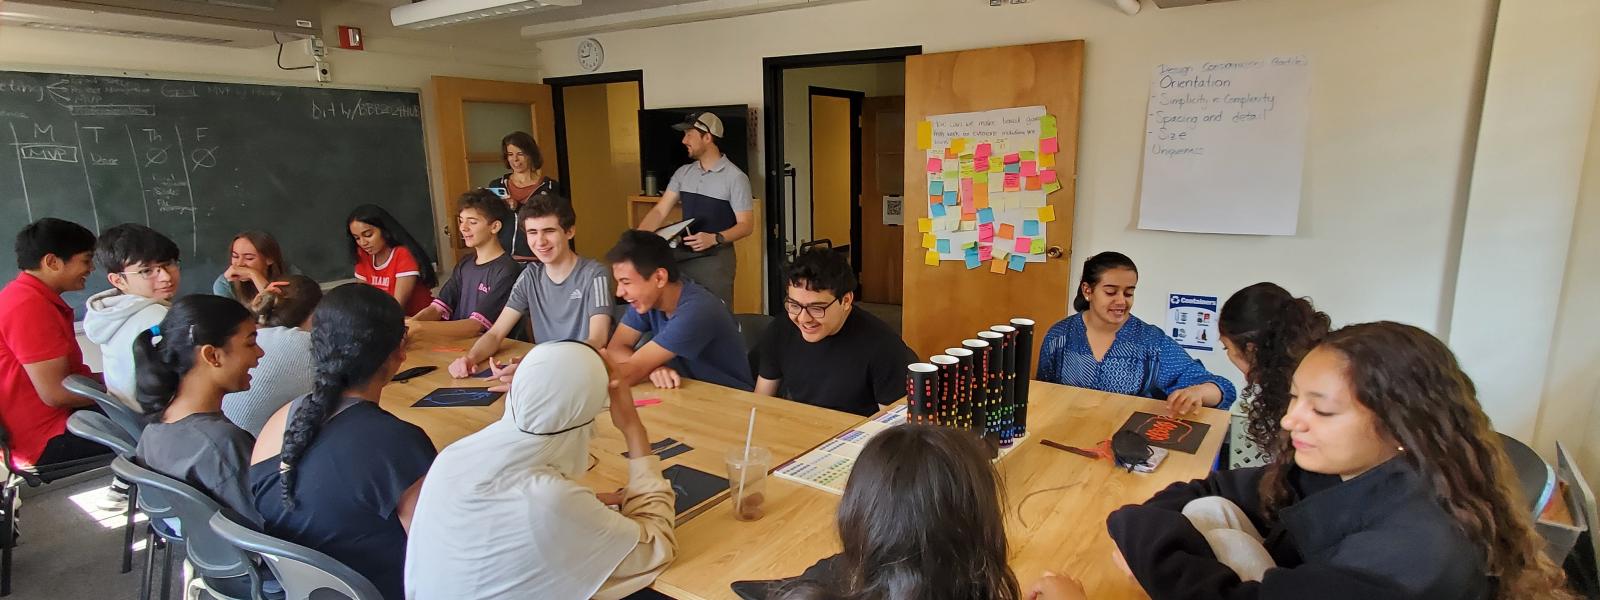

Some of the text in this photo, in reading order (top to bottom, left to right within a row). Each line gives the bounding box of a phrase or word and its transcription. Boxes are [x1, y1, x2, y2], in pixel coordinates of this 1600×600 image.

[1159, 74, 1231, 89] Orientation
[1159, 92, 1209, 110] Simplicity
[1156, 110, 1198, 131] Spacing
[1203, 111, 1222, 122] and
[33, 123, 55, 142] M
[81, 126, 105, 144] T
[196, 127, 209, 143] F
[1157, 127, 1188, 141] Size
[30, 148, 68, 161] MVP
[1181, 297, 1216, 306] Containers
